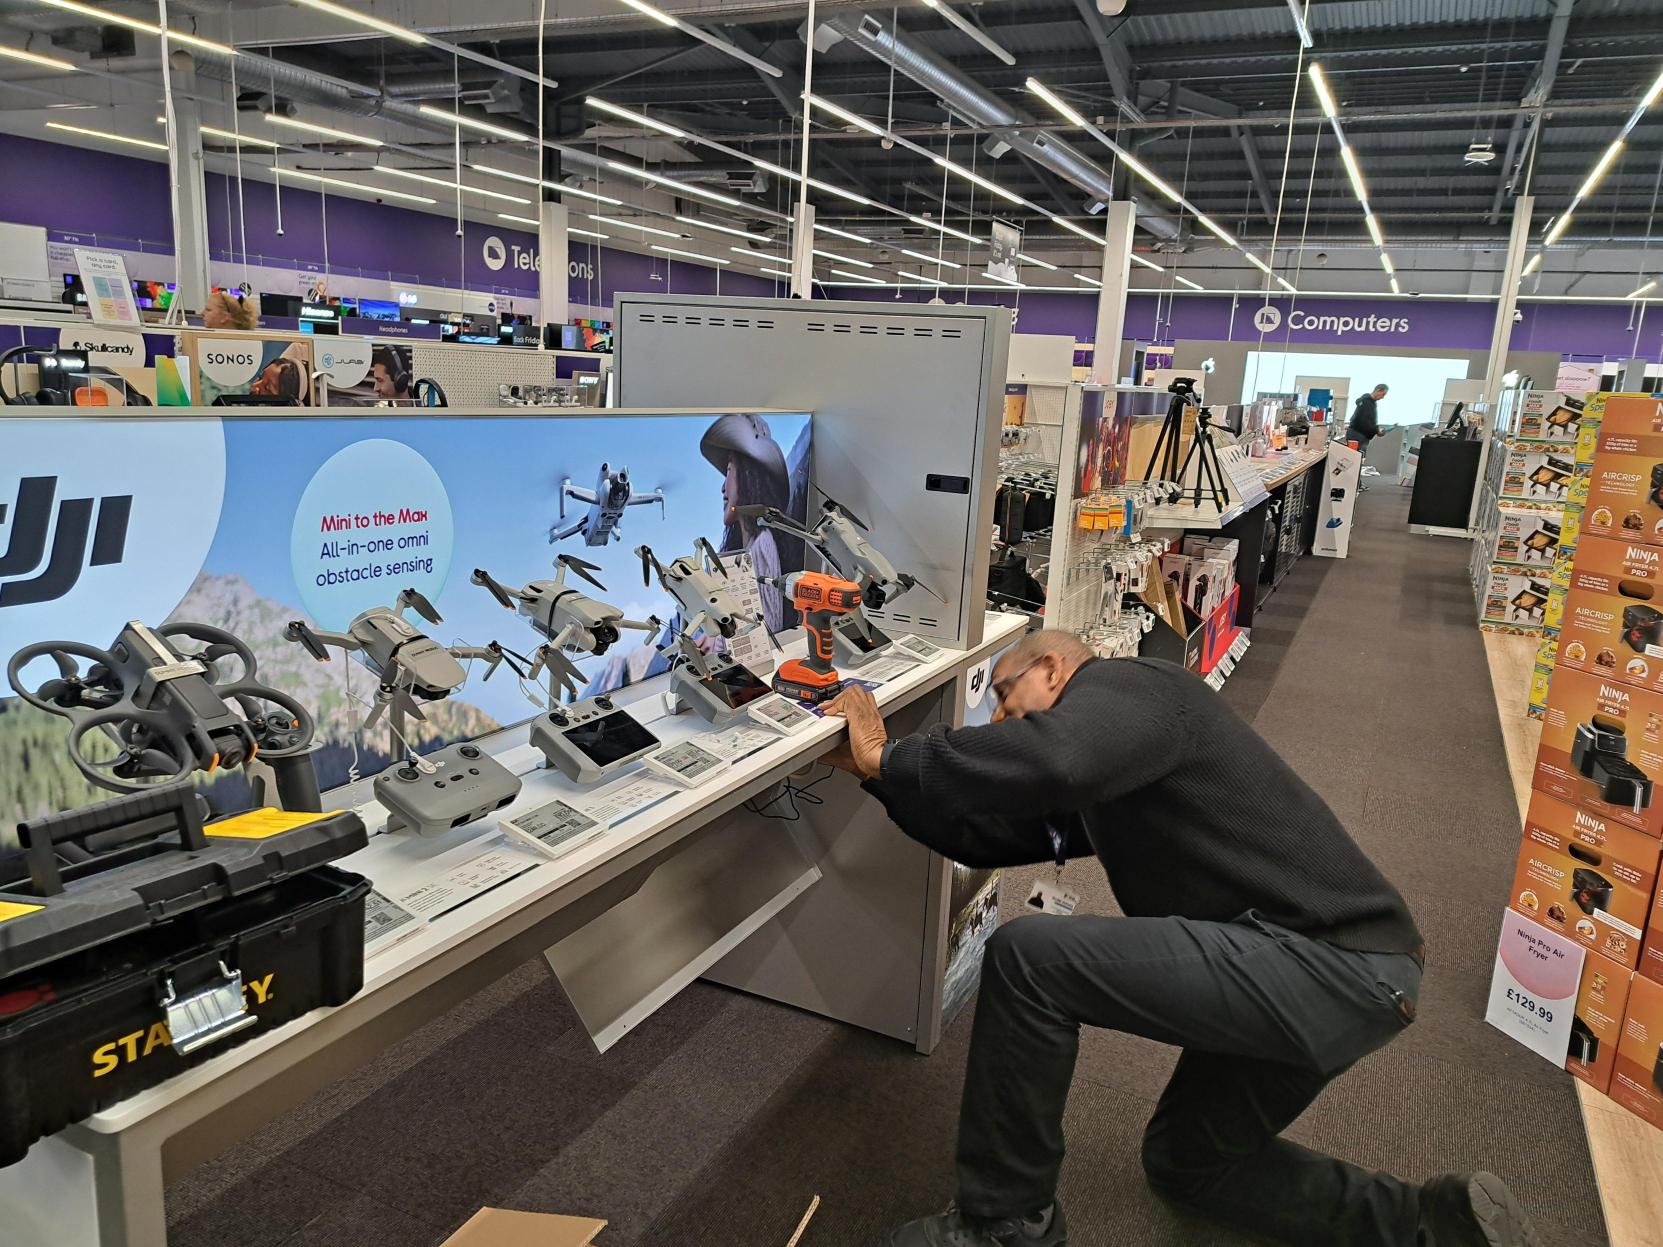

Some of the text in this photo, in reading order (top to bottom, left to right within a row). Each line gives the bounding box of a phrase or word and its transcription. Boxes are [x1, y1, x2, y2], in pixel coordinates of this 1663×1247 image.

[511, 245, 594, 280] Teleons
[1288, 310, 1409, 336] Computers
[84, 340, 134, 356] Skullcandy
[207, 353, 254, 365] SONOS
[1601, 471, 1643, 482] AIRCRISP
[320, 508, 428, 532] Mini to the Max
[320, 530, 429, 560] All-in-one omni
[1625, 546, 1660, 564] NINJA
[316, 556, 433, 587] obstacle sensing
[1631, 568, 1648, 577] PRO
[1575, 607, 1615, 621] AIRCRISP
[1600, 684, 1630, 702] NINJA
[1604, 706, 1620, 715] PRO
[1575, 810, 1606, 832] NINJA
[1580, 834, 1596, 845] PRO
[1528, 858, 1565, 877] AIRCRISP
[1517, 928, 1565, 959] Ninja Pro Air
[1528, 945, 1549, 961] Fryer
[1506, 988, 1553, 1023] £129.99
[92, 973, 274, 1078] STAY
